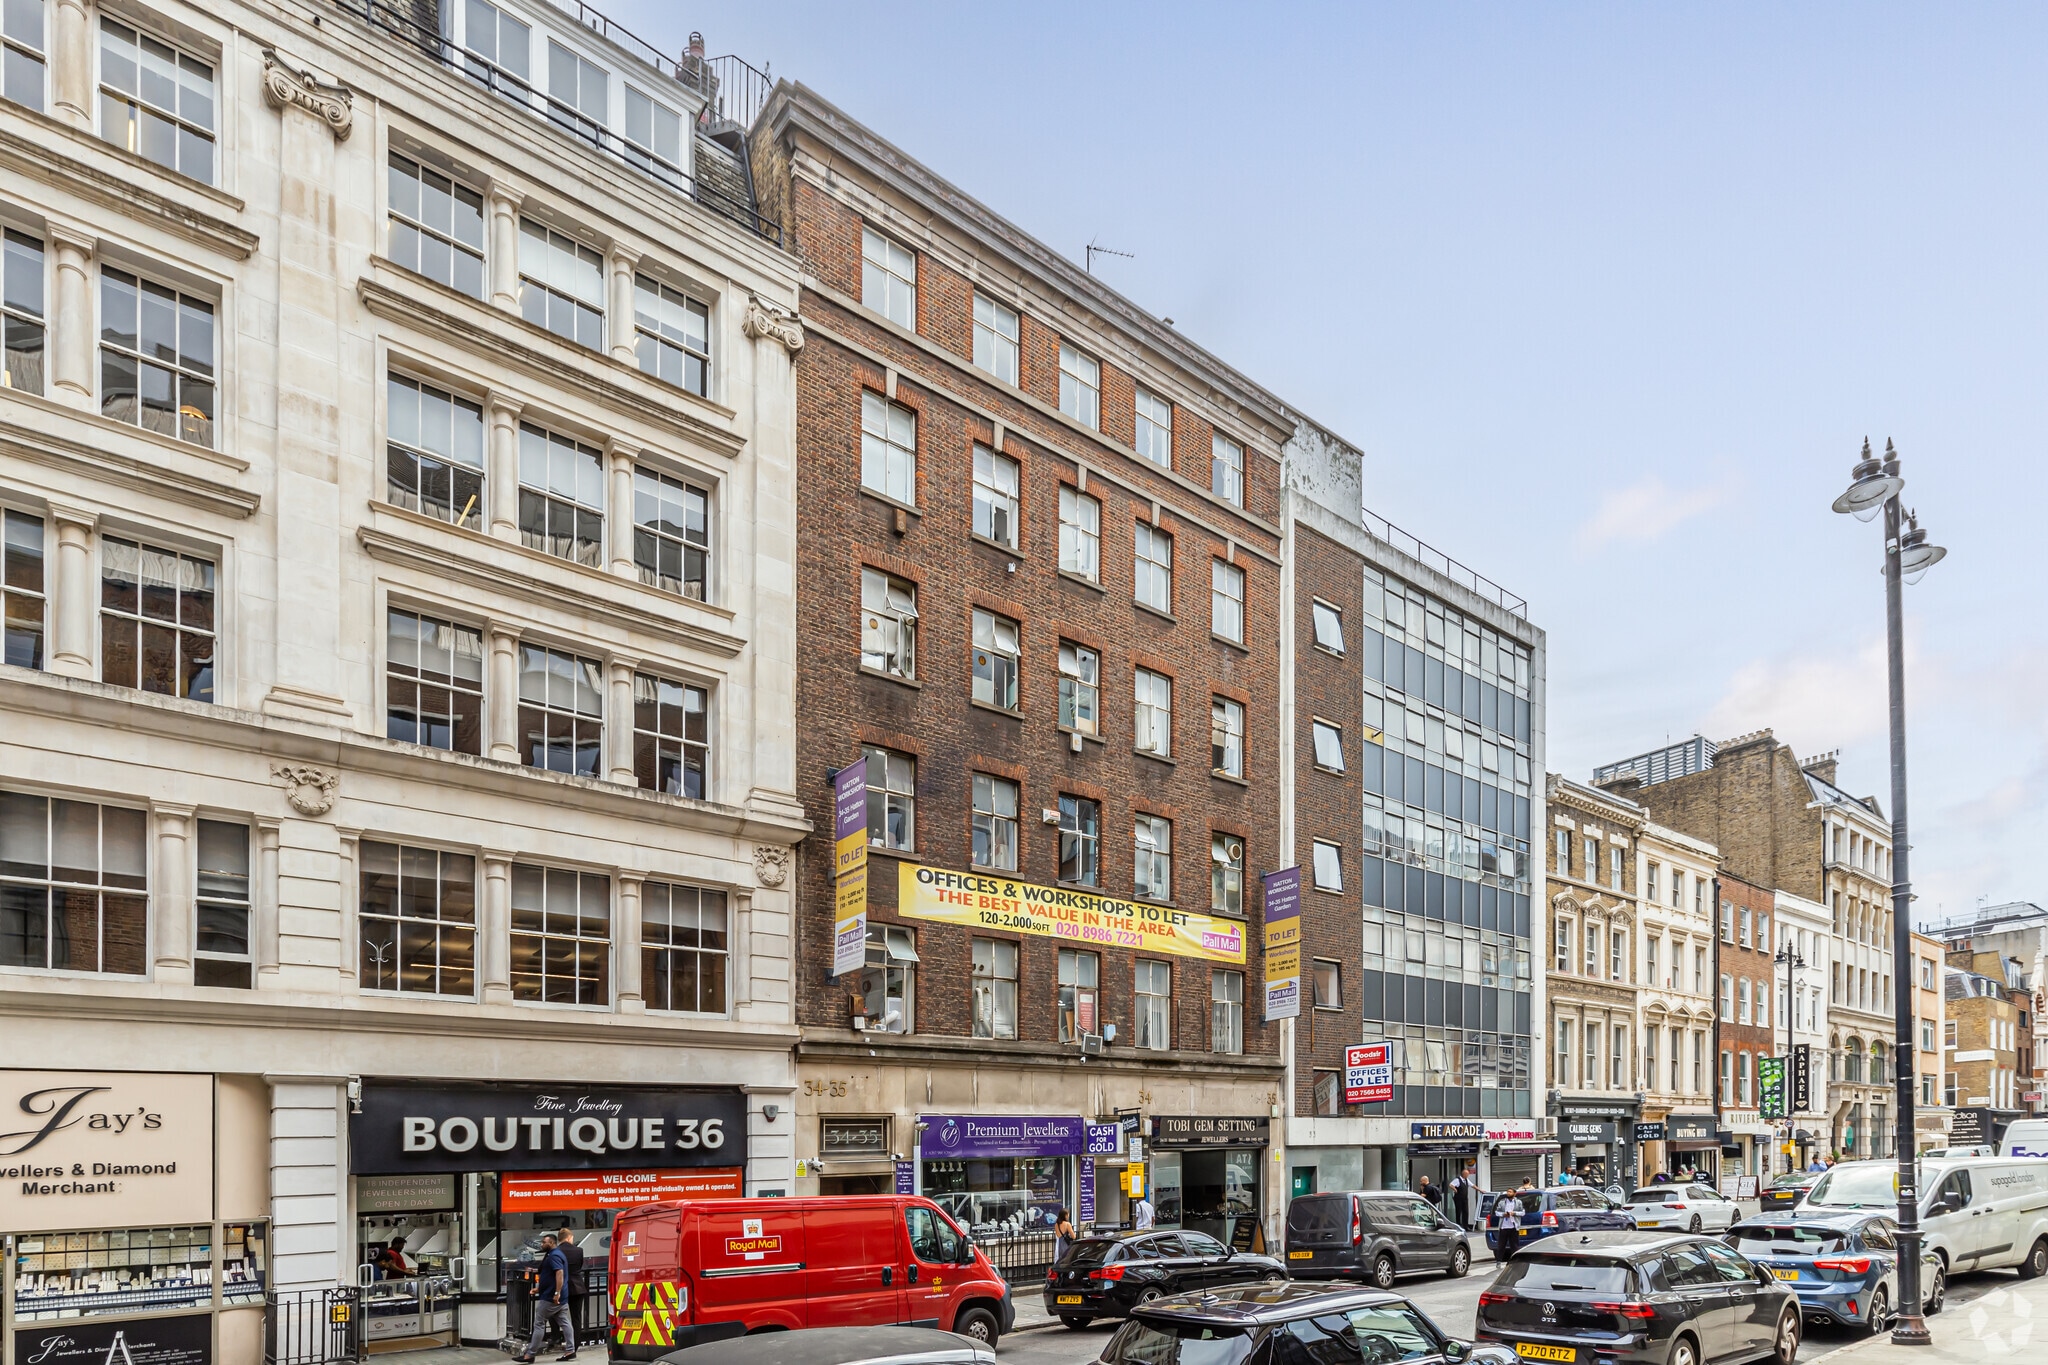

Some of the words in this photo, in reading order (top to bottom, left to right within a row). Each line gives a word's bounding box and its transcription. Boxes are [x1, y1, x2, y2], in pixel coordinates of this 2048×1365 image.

[842, 776, 860, 791] HATTON
[838, 782, 865, 802] WORKSHOPS
[838, 806, 850, 817] 34-35
[850, 800, 864, 812] Hatton
[844, 812, 859, 824] Garden
[840, 854, 850, 866] TO
[852, 846, 864, 860] LET
[840, 874, 864, 888] Workshops
[1272, 878, 1292, 888] HATTON
[1268, 883, 1298, 896] WORKSHOPS
[916, 868, 998, 894] OFFICES
[1004, 883, 1016, 898] &
[1022, 885, 1134, 918] WORKSHOPS
[1138, 906, 1160, 920] TO
[1164, 910, 1188, 926] LET
[936, 888, 973, 906] THE
[979, 895, 1021, 913] BEST
[1026, 903, 1078, 922] VALUE
[1083, 912, 1099, 926] IN
[1104, 916, 1134, 930] THE
[1138, 922, 1176, 938] AREA
[1274, 904, 1292, 912] Garden
[979, 911, 1032, 929] 120-2,000
[1032, 922, 1042, 931] SQ
[1042, 924, 1050, 932] FT
[839, 933, 850, 946] Pall
[850, 930, 862, 940] Mall
[1056, 922, 1078, 938] 020
[1083, 926, 1112, 942] 8986
[1116, 931, 1143, 946] 7221
[1270, 932, 1280, 941] TO
[1282, 928, 1296, 938] LET
[1204, 936, 1220, 948] Pall
[1220, 938, 1240, 952] Mall
[1269, 948, 1296, 958] Workshops
[1270, 990, 1281, 999] Pall
[1282, 988, 1296, 996] Mall
[1350, 1068, 1387, 1076] OFFICES
[1798, 1046, 1806, 1099] RAPHAEL
[1348, 1078, 1364, 1086] TO
[1368, 1076, 1389, 1084] LET
[804, 1080, 847, 1097] 34-35
[534, 1095, 566, 1112] Fine
[569, 1096, 622, 1115] Jewellery
[0, 1087, 162, 1155] Jay's
[1168, 1120, 1190, 1132] TOBI
[1194, 1120, 1214, 1132] GEM
[1218, 1120, 1256, 1132] SETTING
[403, 1116, 665, 1154] BOUTIQUE
[675, 1118, 724, 1149] 36
[830, 1130, 878, 1144] 34-35
[967, 1122, 1020, 1136] Premium
[1021, 1122, 1068, 1140] Jewellers
[1090, 1126, 1114, 1136] CASH
[1424, 1125, 1442, 1136] THE
[1444, 1125, 1480, 1136] ARCADE
[1676, 1128, 1696, 1138] BUYING
[1696, 1128, 1706, 1138] HUB
[1089, 1142, 1114, 1152] GOLD
[72, 1164, 85, 1176] &
[92, 1162, 176, 1176] Diamond
[379, 1178, 441, 1187] INDEPENDENT
[602, 1174, 656, 1184] WELCOME
[22, 1181, 115, 1195] Merchant
[361, 1188, 416, 1197] JEWELLERS
[509, 1190, 532, 1198] Please
[552, 1188, 574, 1196] inside,
[596, 1186, 618, 1194] booths
[652, 1184, 684, 1192] individually
[375, 1200, 400, 1208] OPEN
[730, 1240, 756, 1252] Royal
[758, 1238, 778, 1248] Mail
[28, 1334, 75, 1364] Jay's
[56, 1348, 86, 1357] Jewellers
[1520, 1346, 1547, 1356] PJ70
[1549, 1348, 1570, 1360] RTZ
